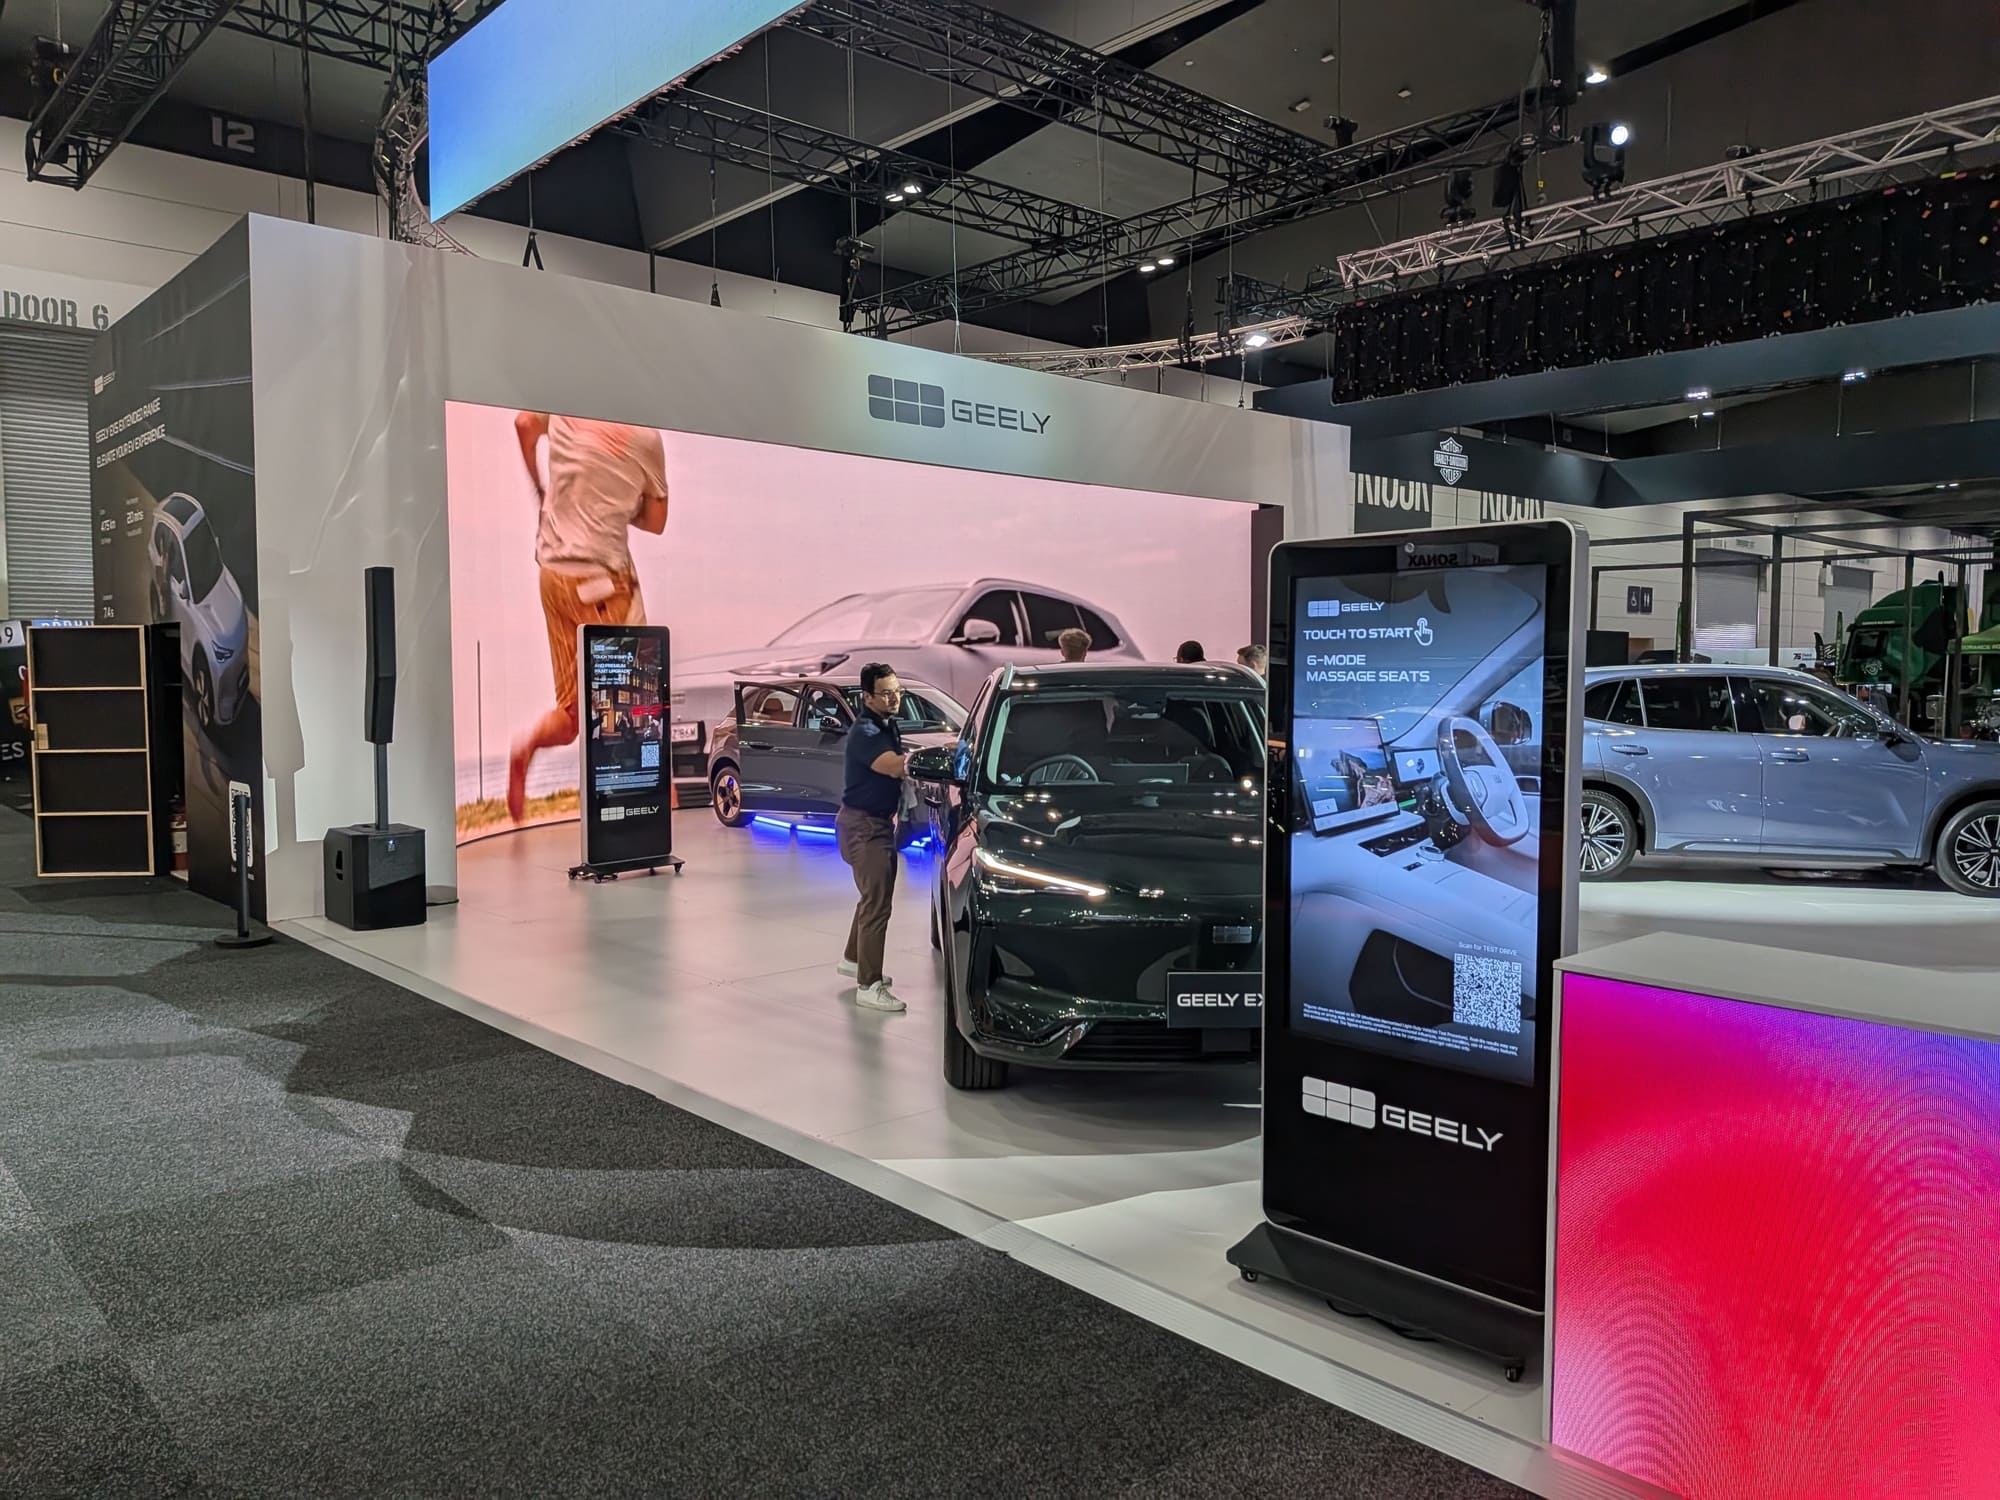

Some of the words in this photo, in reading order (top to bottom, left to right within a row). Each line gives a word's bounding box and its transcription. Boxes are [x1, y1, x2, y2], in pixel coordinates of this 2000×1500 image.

[211, 116, 255, 153] 12
[3, 290, 77, 328] DOOR
[92, 304, 109, 331] 6
[951, 399, 1052, 434] GEELY
[1341, 601, 1384, 612] GEELY
[1303, 629, 1347, 640] TOUCH
[1348, 628, 1367, 639] TO
[1368, 627, 1413, 638] START
[1306, 654, 1367, 666] 6-MODE
[1306, 670, 1376, 682] MASSAGE
[1378, 670, 1430, 682] SEATS
[625, 806, 660, 817] GEELY
[1177, 993, 1240, 1007] GEELY
[1382, 1103, 1503, 1152] GEELY
